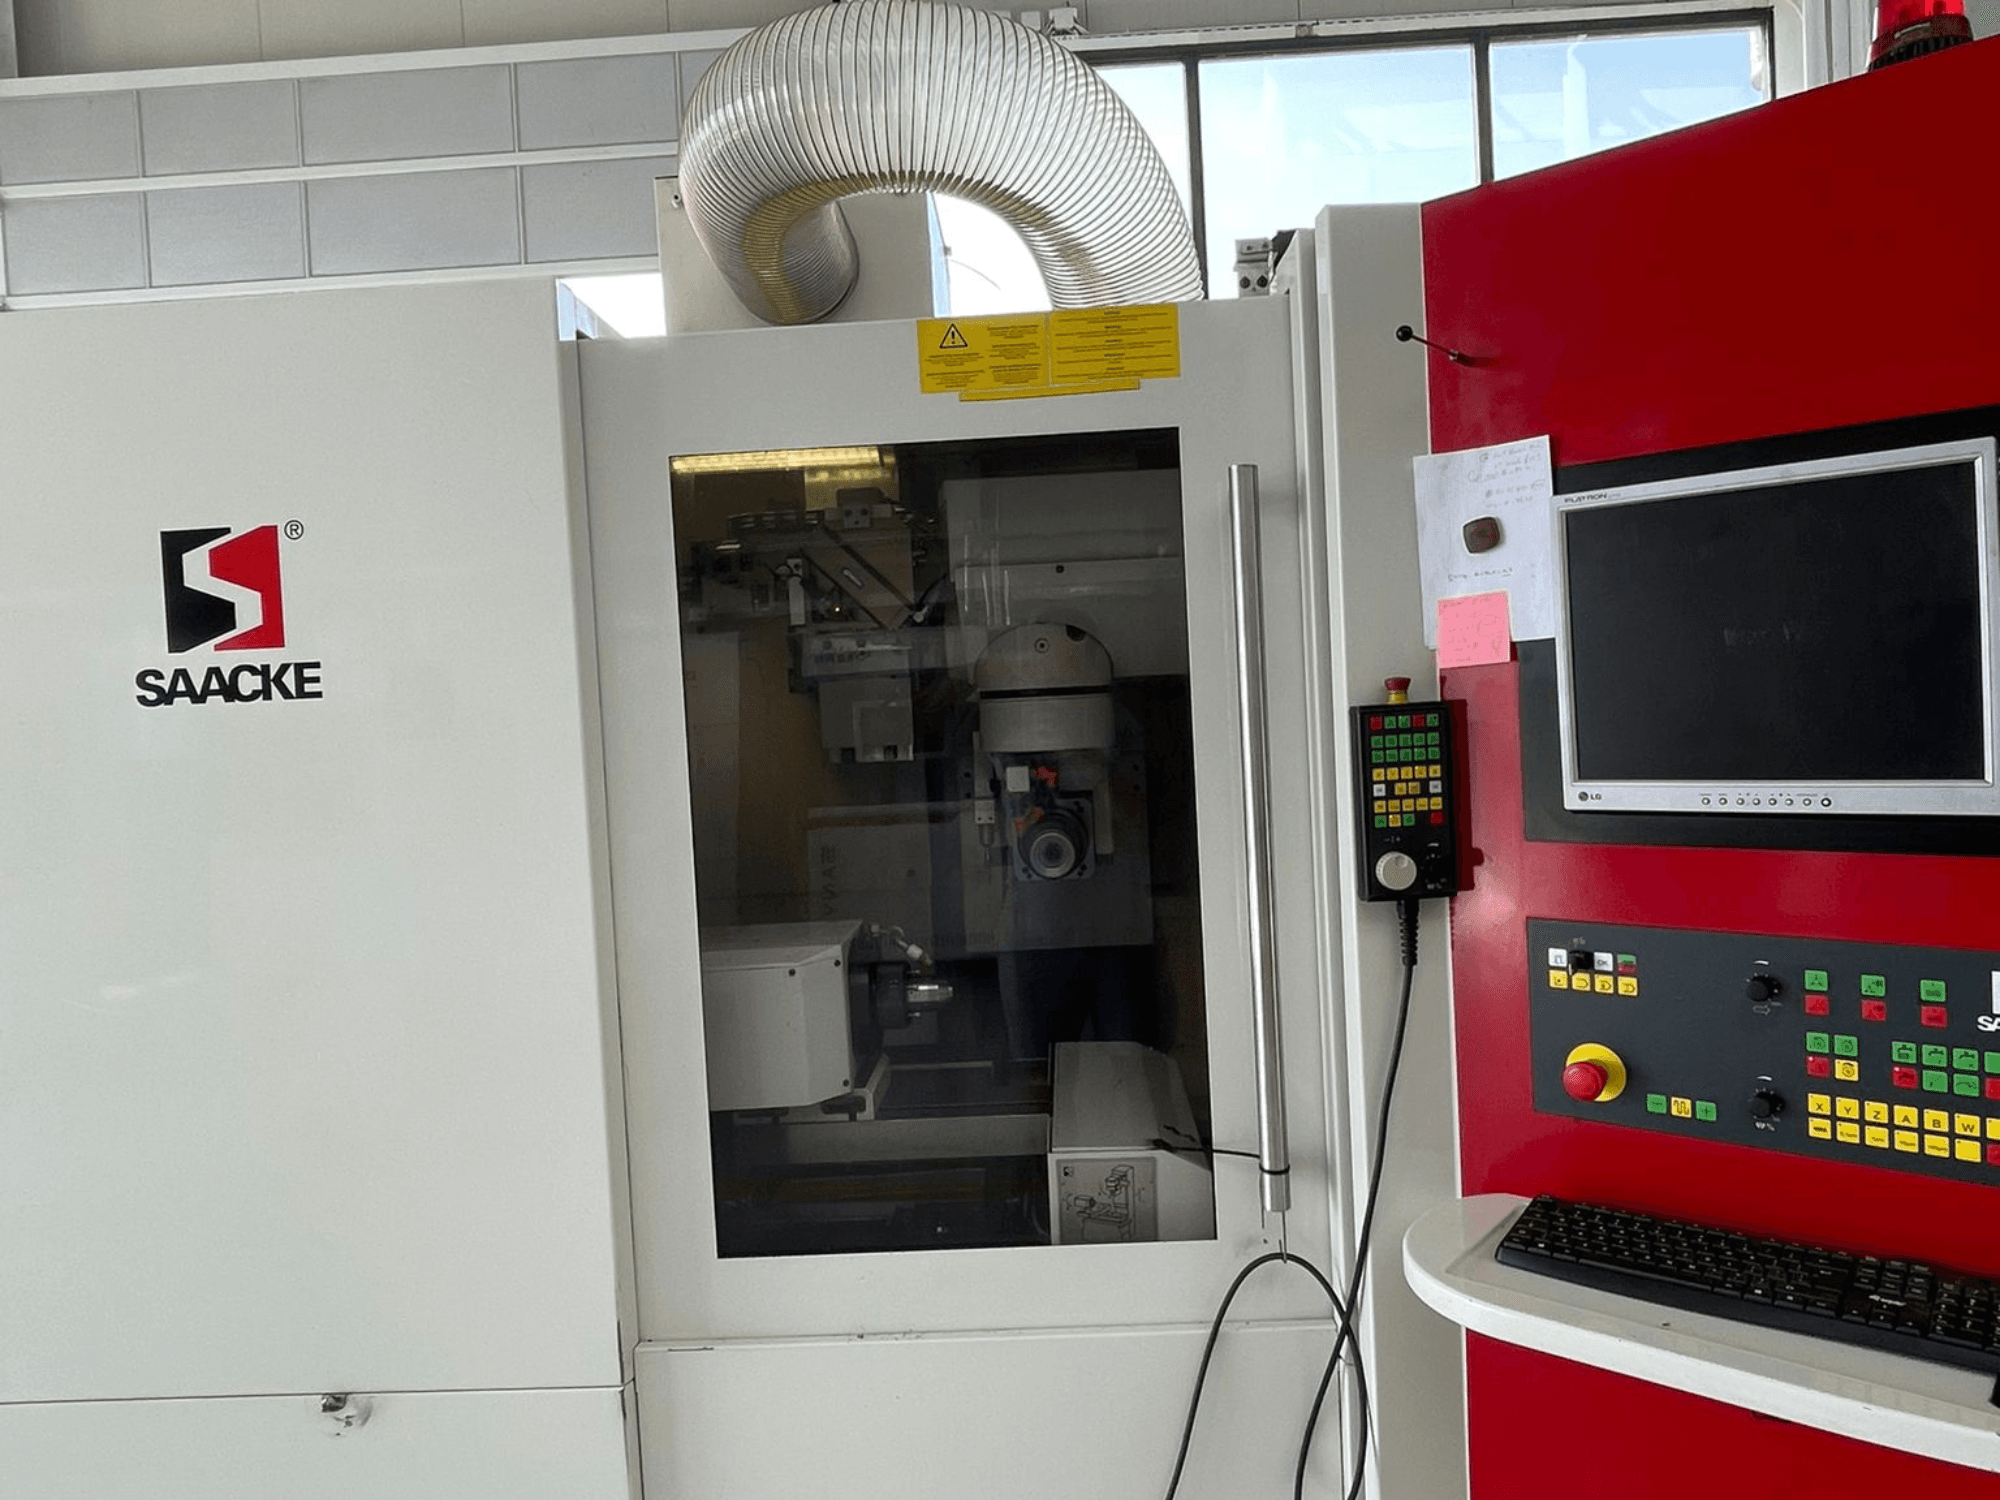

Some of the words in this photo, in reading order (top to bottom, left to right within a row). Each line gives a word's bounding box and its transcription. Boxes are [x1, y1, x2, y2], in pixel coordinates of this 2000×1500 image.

[135, 661, 323, 707] SAACKE
[1815, 1102, 1824, 1112] X
[1844, 1106, 1853, 1116] Y
[1873, 1110, 1882, 1121] Z
[1901, 1114, 1912, 1125] A
[1932, 1118, 1942, 1129] B
[1961, 1122, 1975, 1134] W
